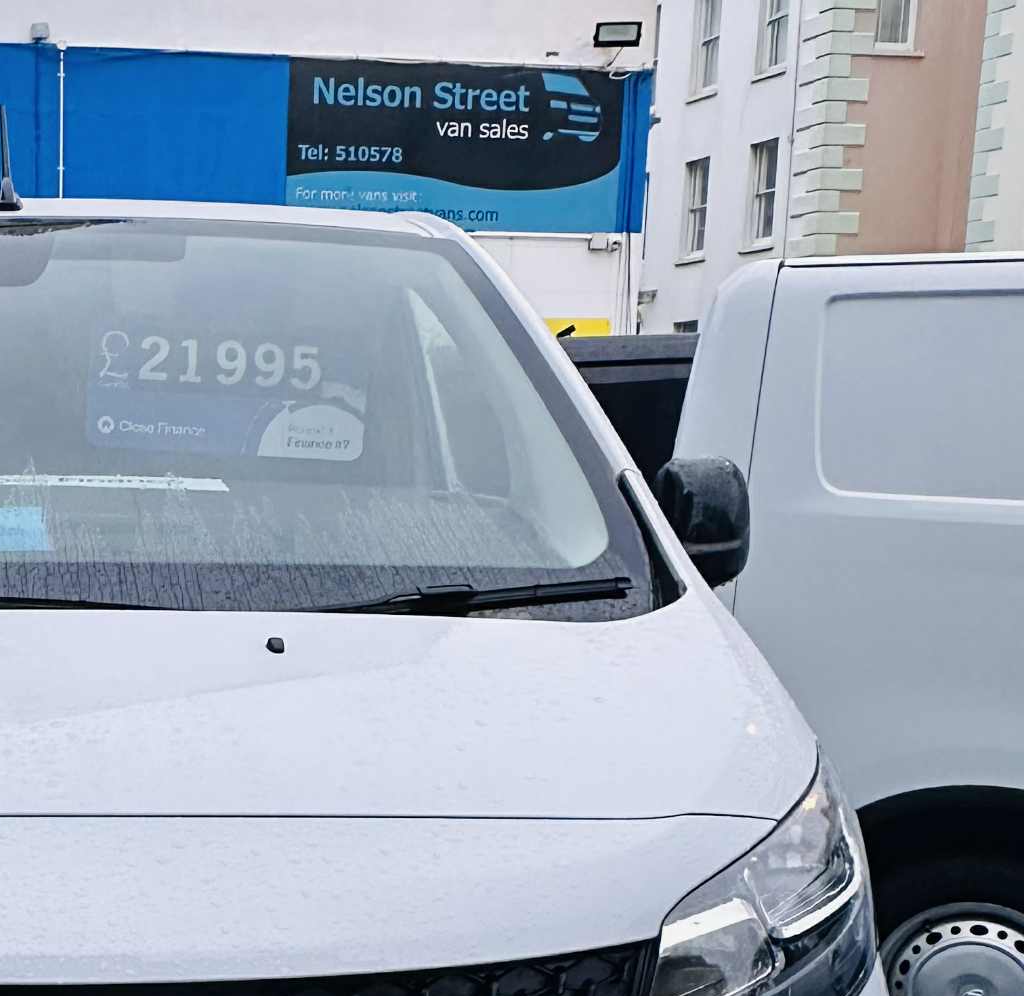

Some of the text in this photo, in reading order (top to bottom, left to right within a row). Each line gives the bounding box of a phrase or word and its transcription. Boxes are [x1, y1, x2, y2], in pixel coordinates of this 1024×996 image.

[313, 76, 530, 112] Nelson Street
[436, 118, 528, 140] van sales
[298, 144, 403, 163] Tel: 510578
[296, 187, 317, 200] For
[358, 190, 388, 201] vans
